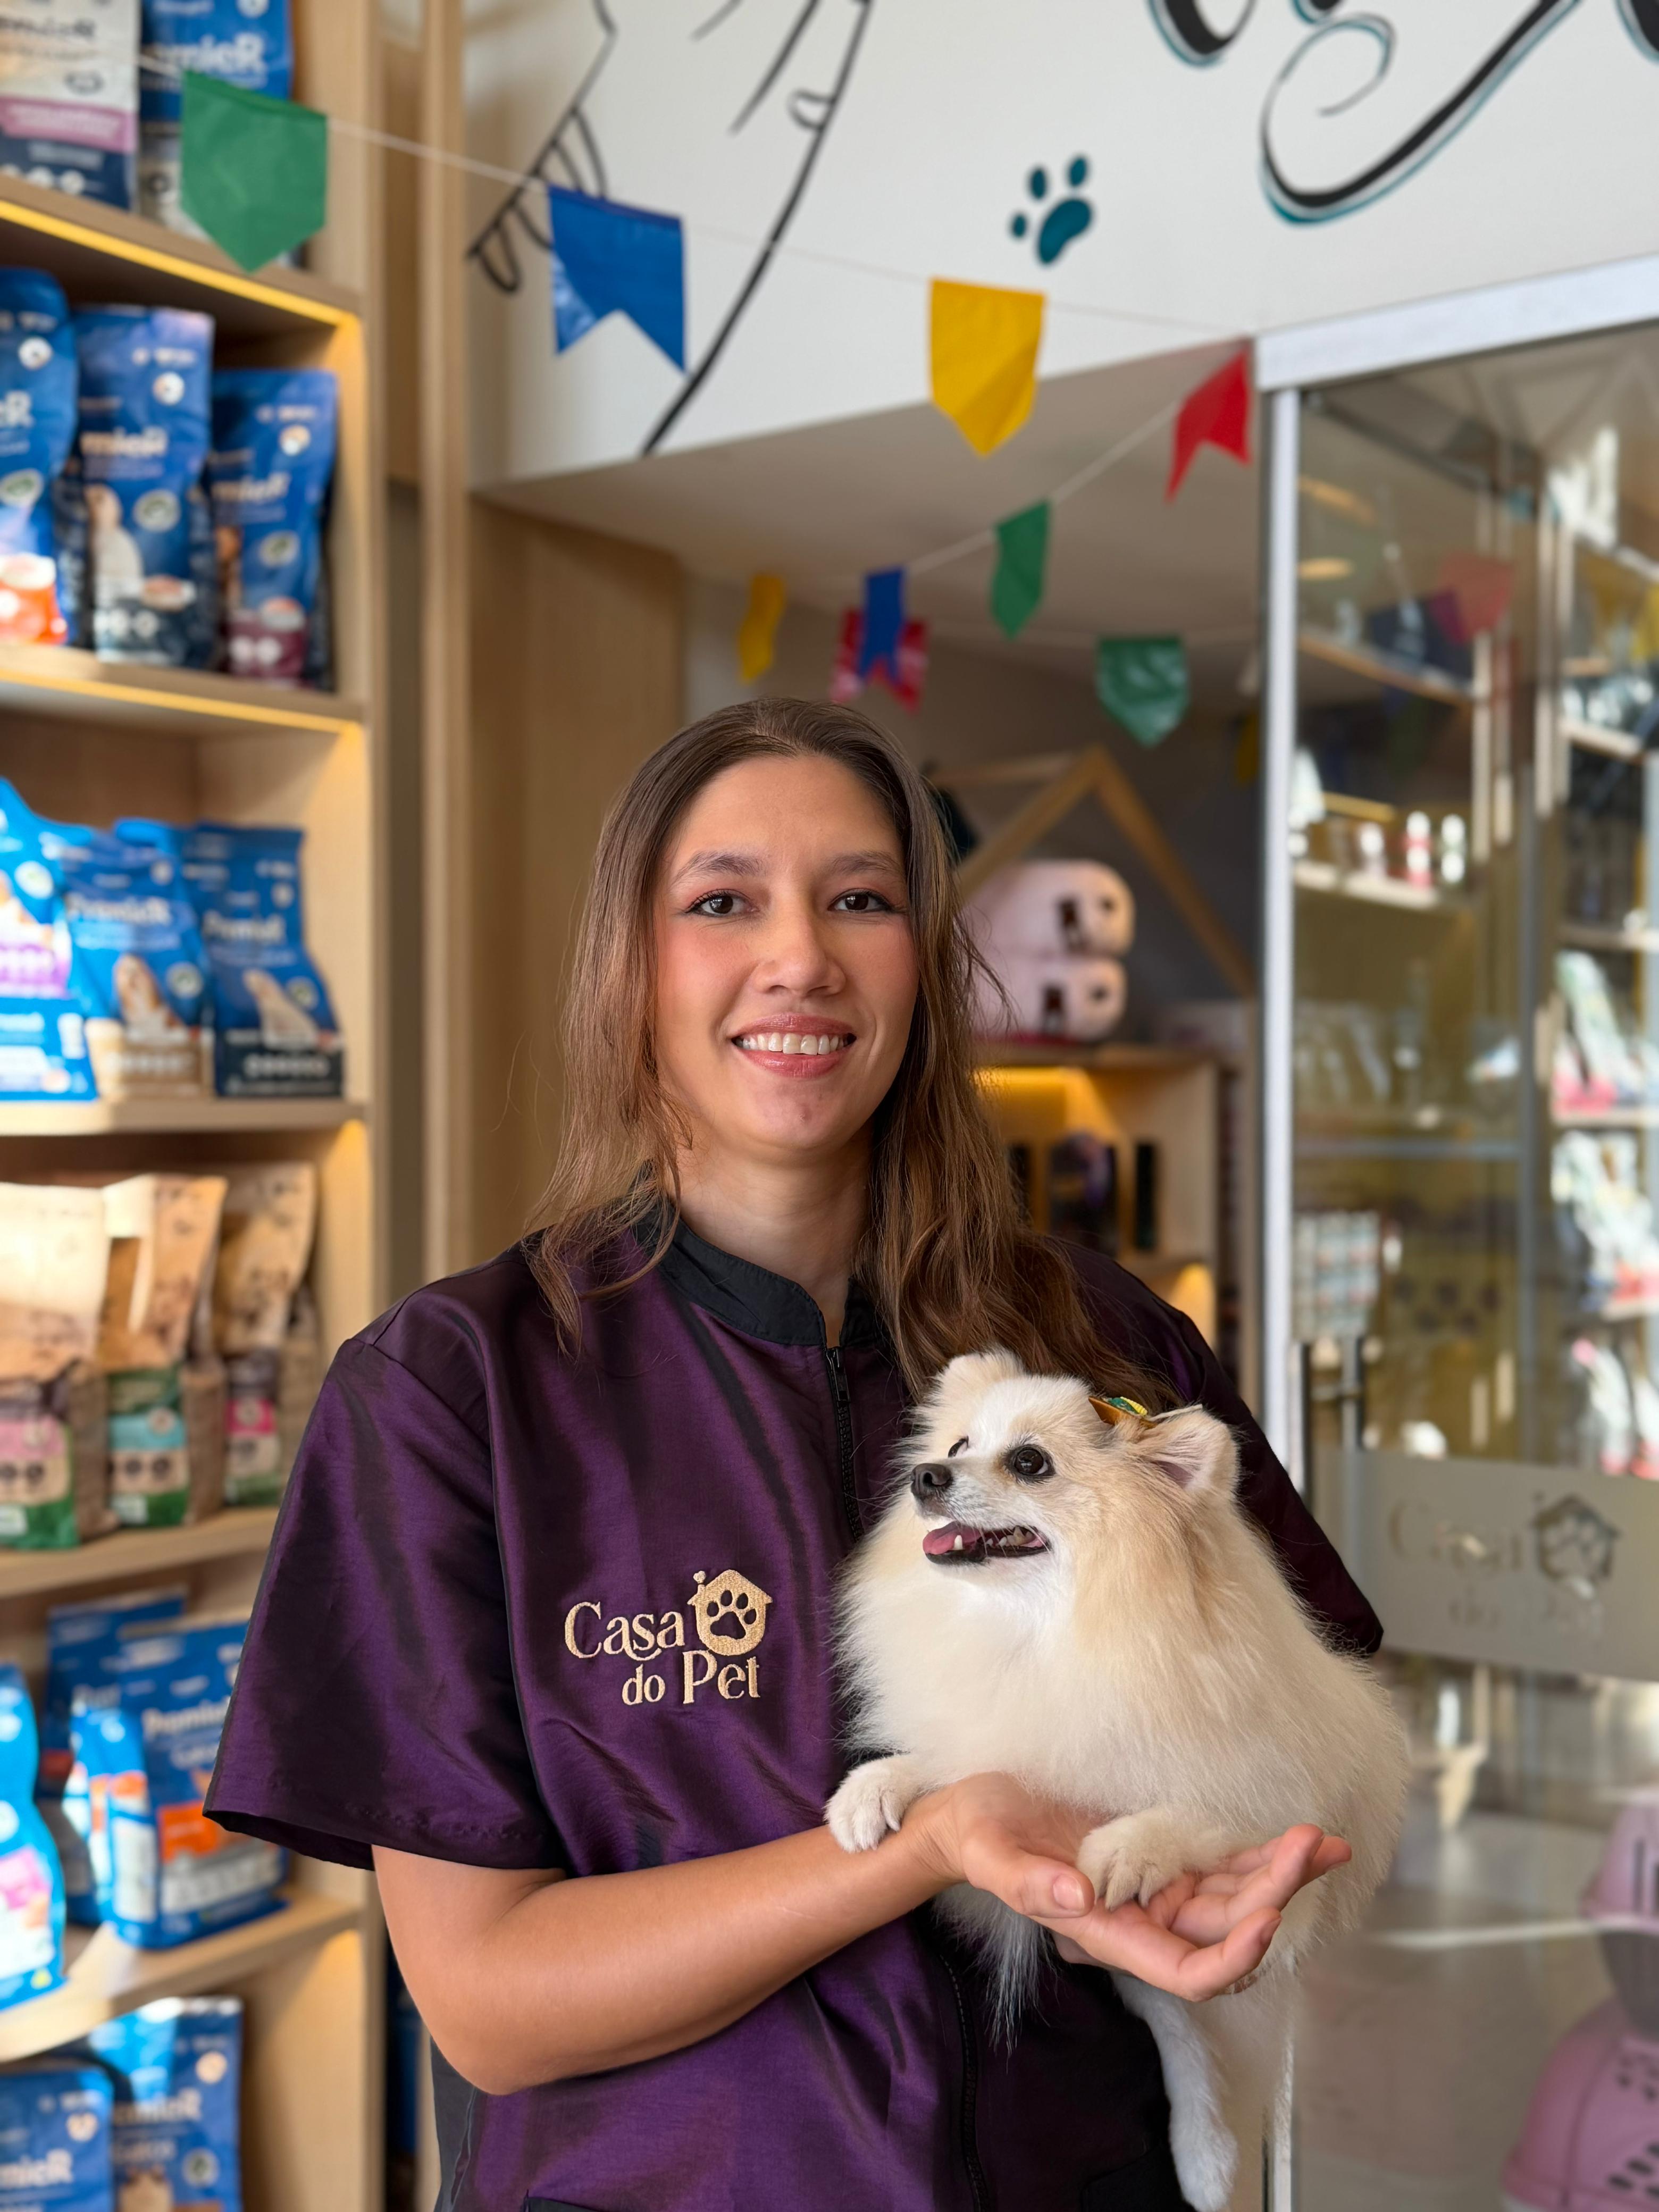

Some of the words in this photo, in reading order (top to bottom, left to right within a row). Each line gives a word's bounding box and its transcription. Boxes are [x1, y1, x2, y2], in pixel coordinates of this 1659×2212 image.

[565, 1601, 685, 1661] Casa
[622, 1664, 665, 1705] do
[682, 1649, 760, 1705] Pet
